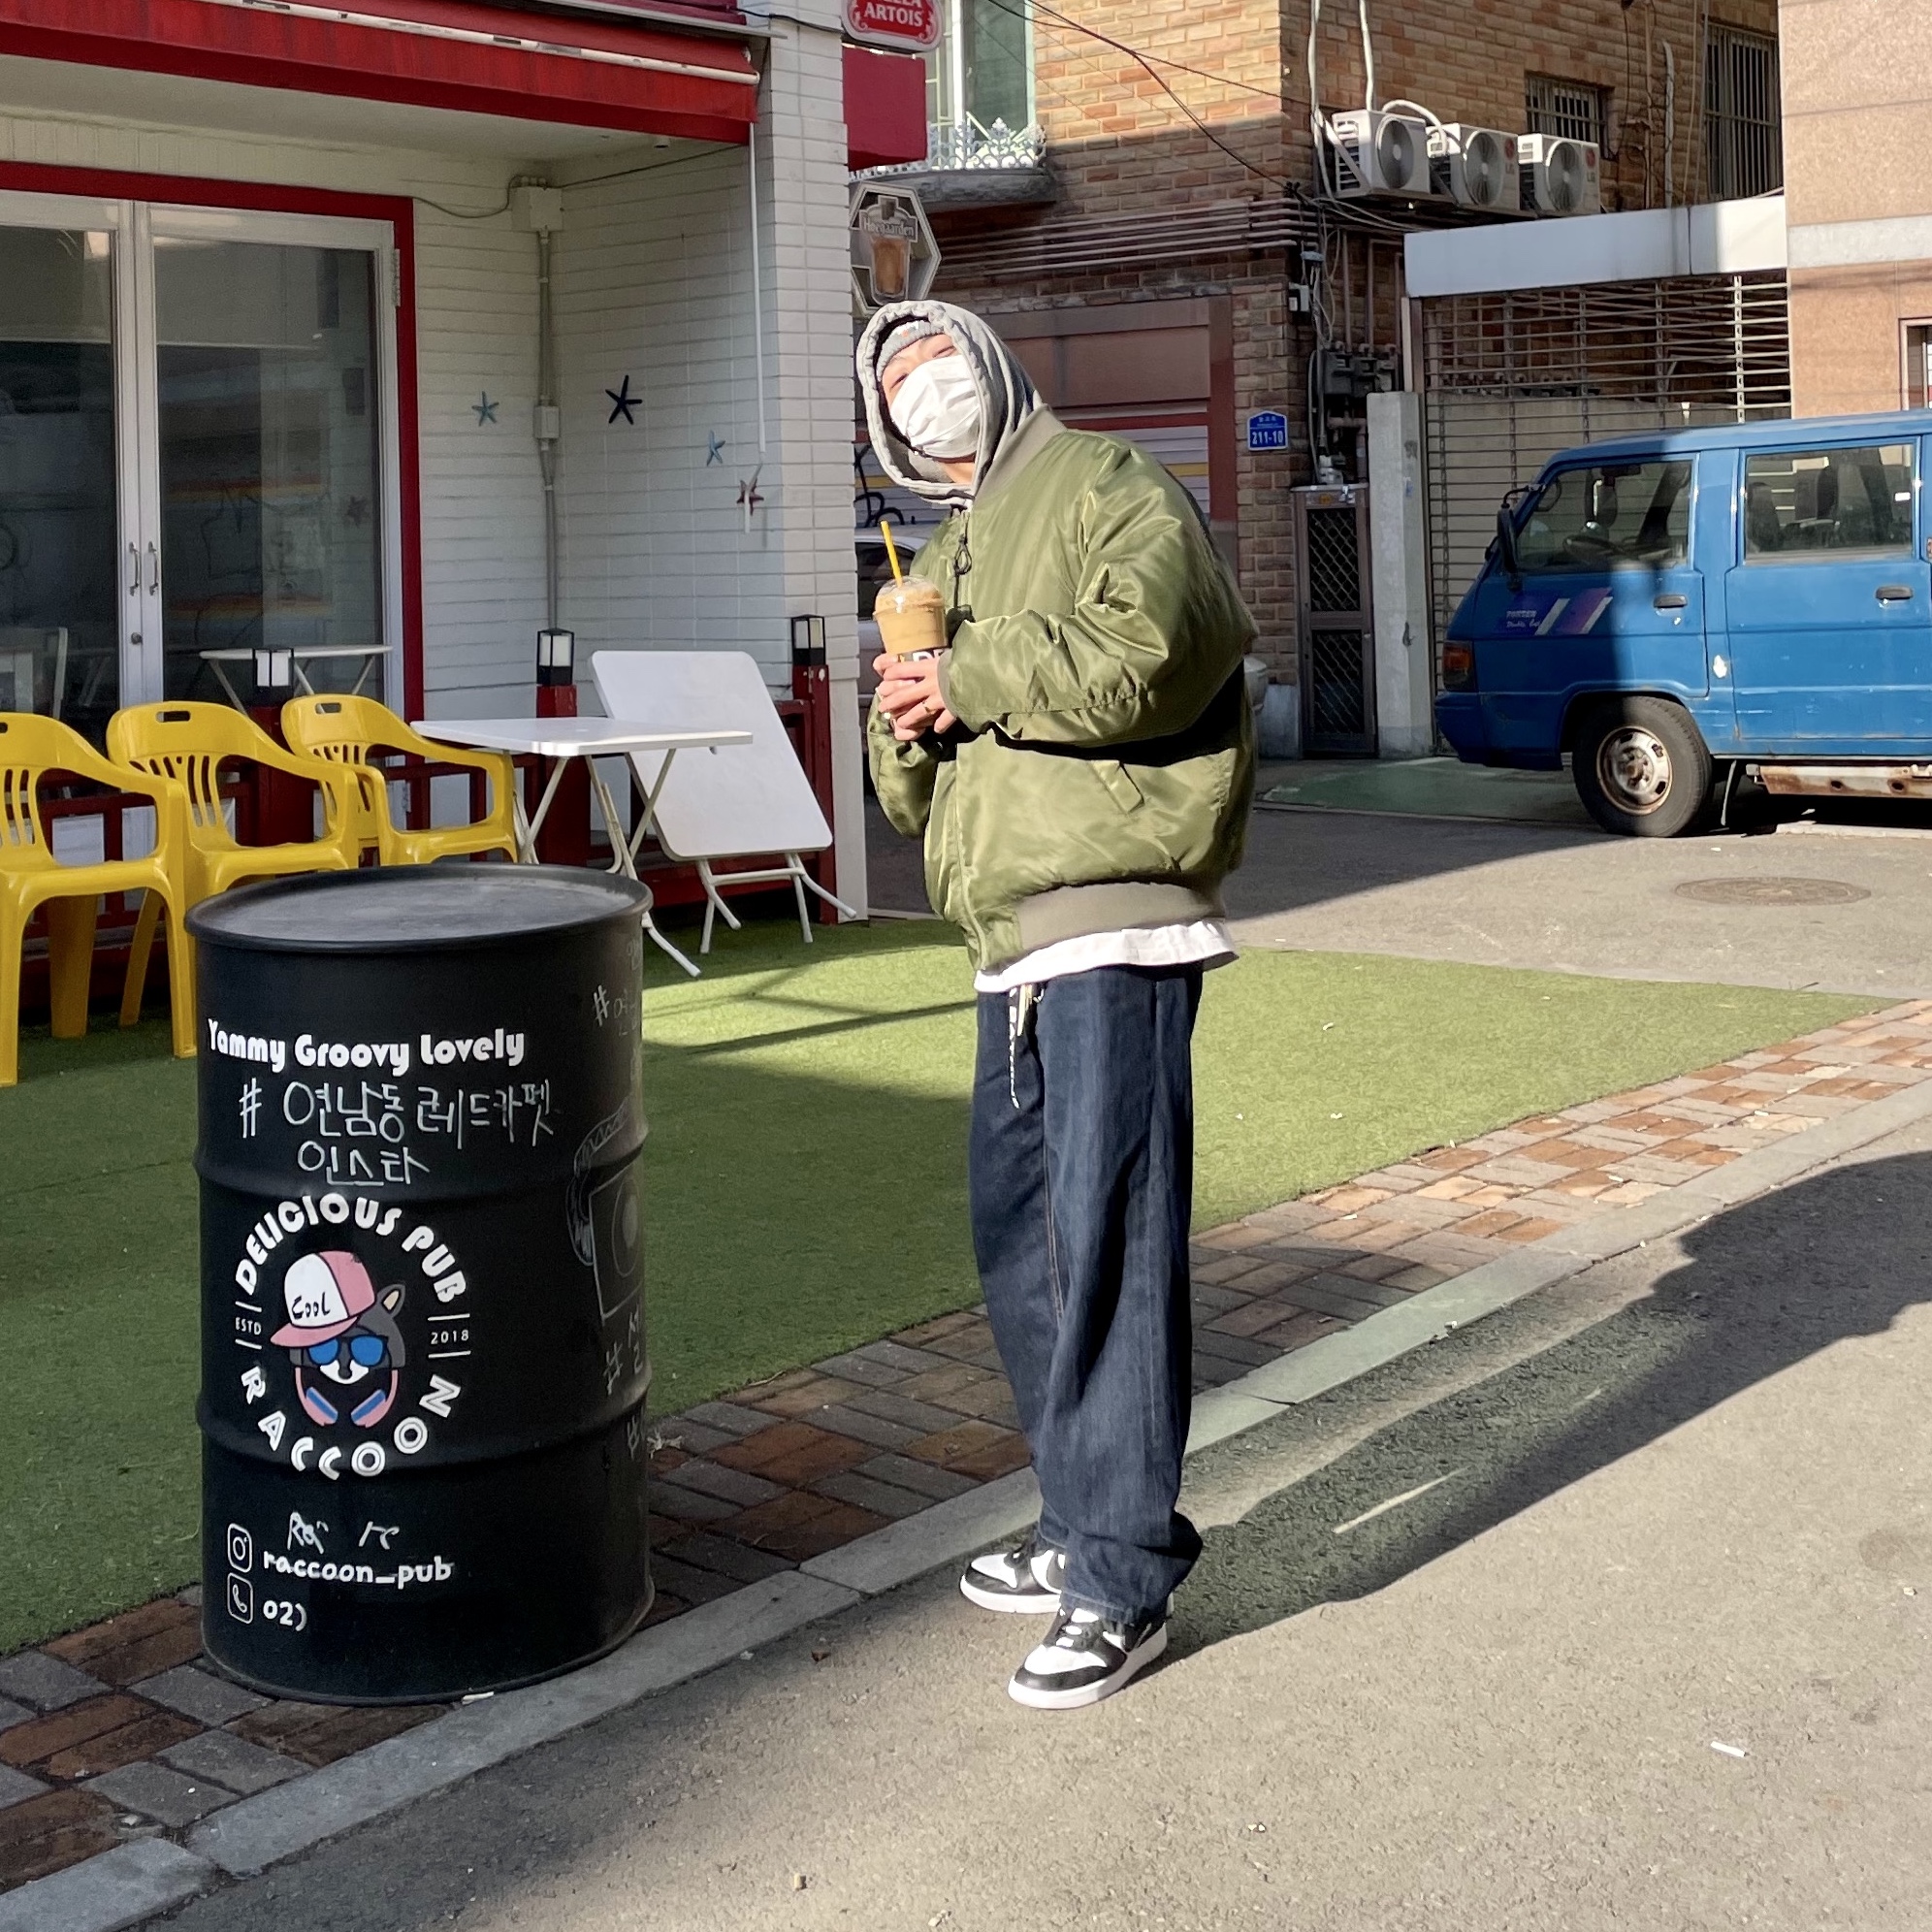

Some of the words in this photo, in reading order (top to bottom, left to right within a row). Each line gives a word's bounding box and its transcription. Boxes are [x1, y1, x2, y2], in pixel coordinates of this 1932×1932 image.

[863, 2, 923, 27] ARTOIS
[1252, 430, 1283, 444] 211-10
[294, 1034, 410, 1078] Groovy
[420, 1028, 525, 1067] Lovely
[282, 1079, 405, 1143] 연남동
[416, 1079, 554, 1150] 레드카펫
[297, 1140, 431, 1187] 인스타
[235, 1192, 402, 1296] DELICIOUS
[401, 1225, 467, 1304] PUB
[235, 1317, 262, 1336] ESTD
[430, 1330, 470, 1345] 2018
[241, 1365, 462, 1481] RACCOON
[263, 1551, 453, 1590] raccoon_pub
[263, 1600, 307, 1632] 02)
